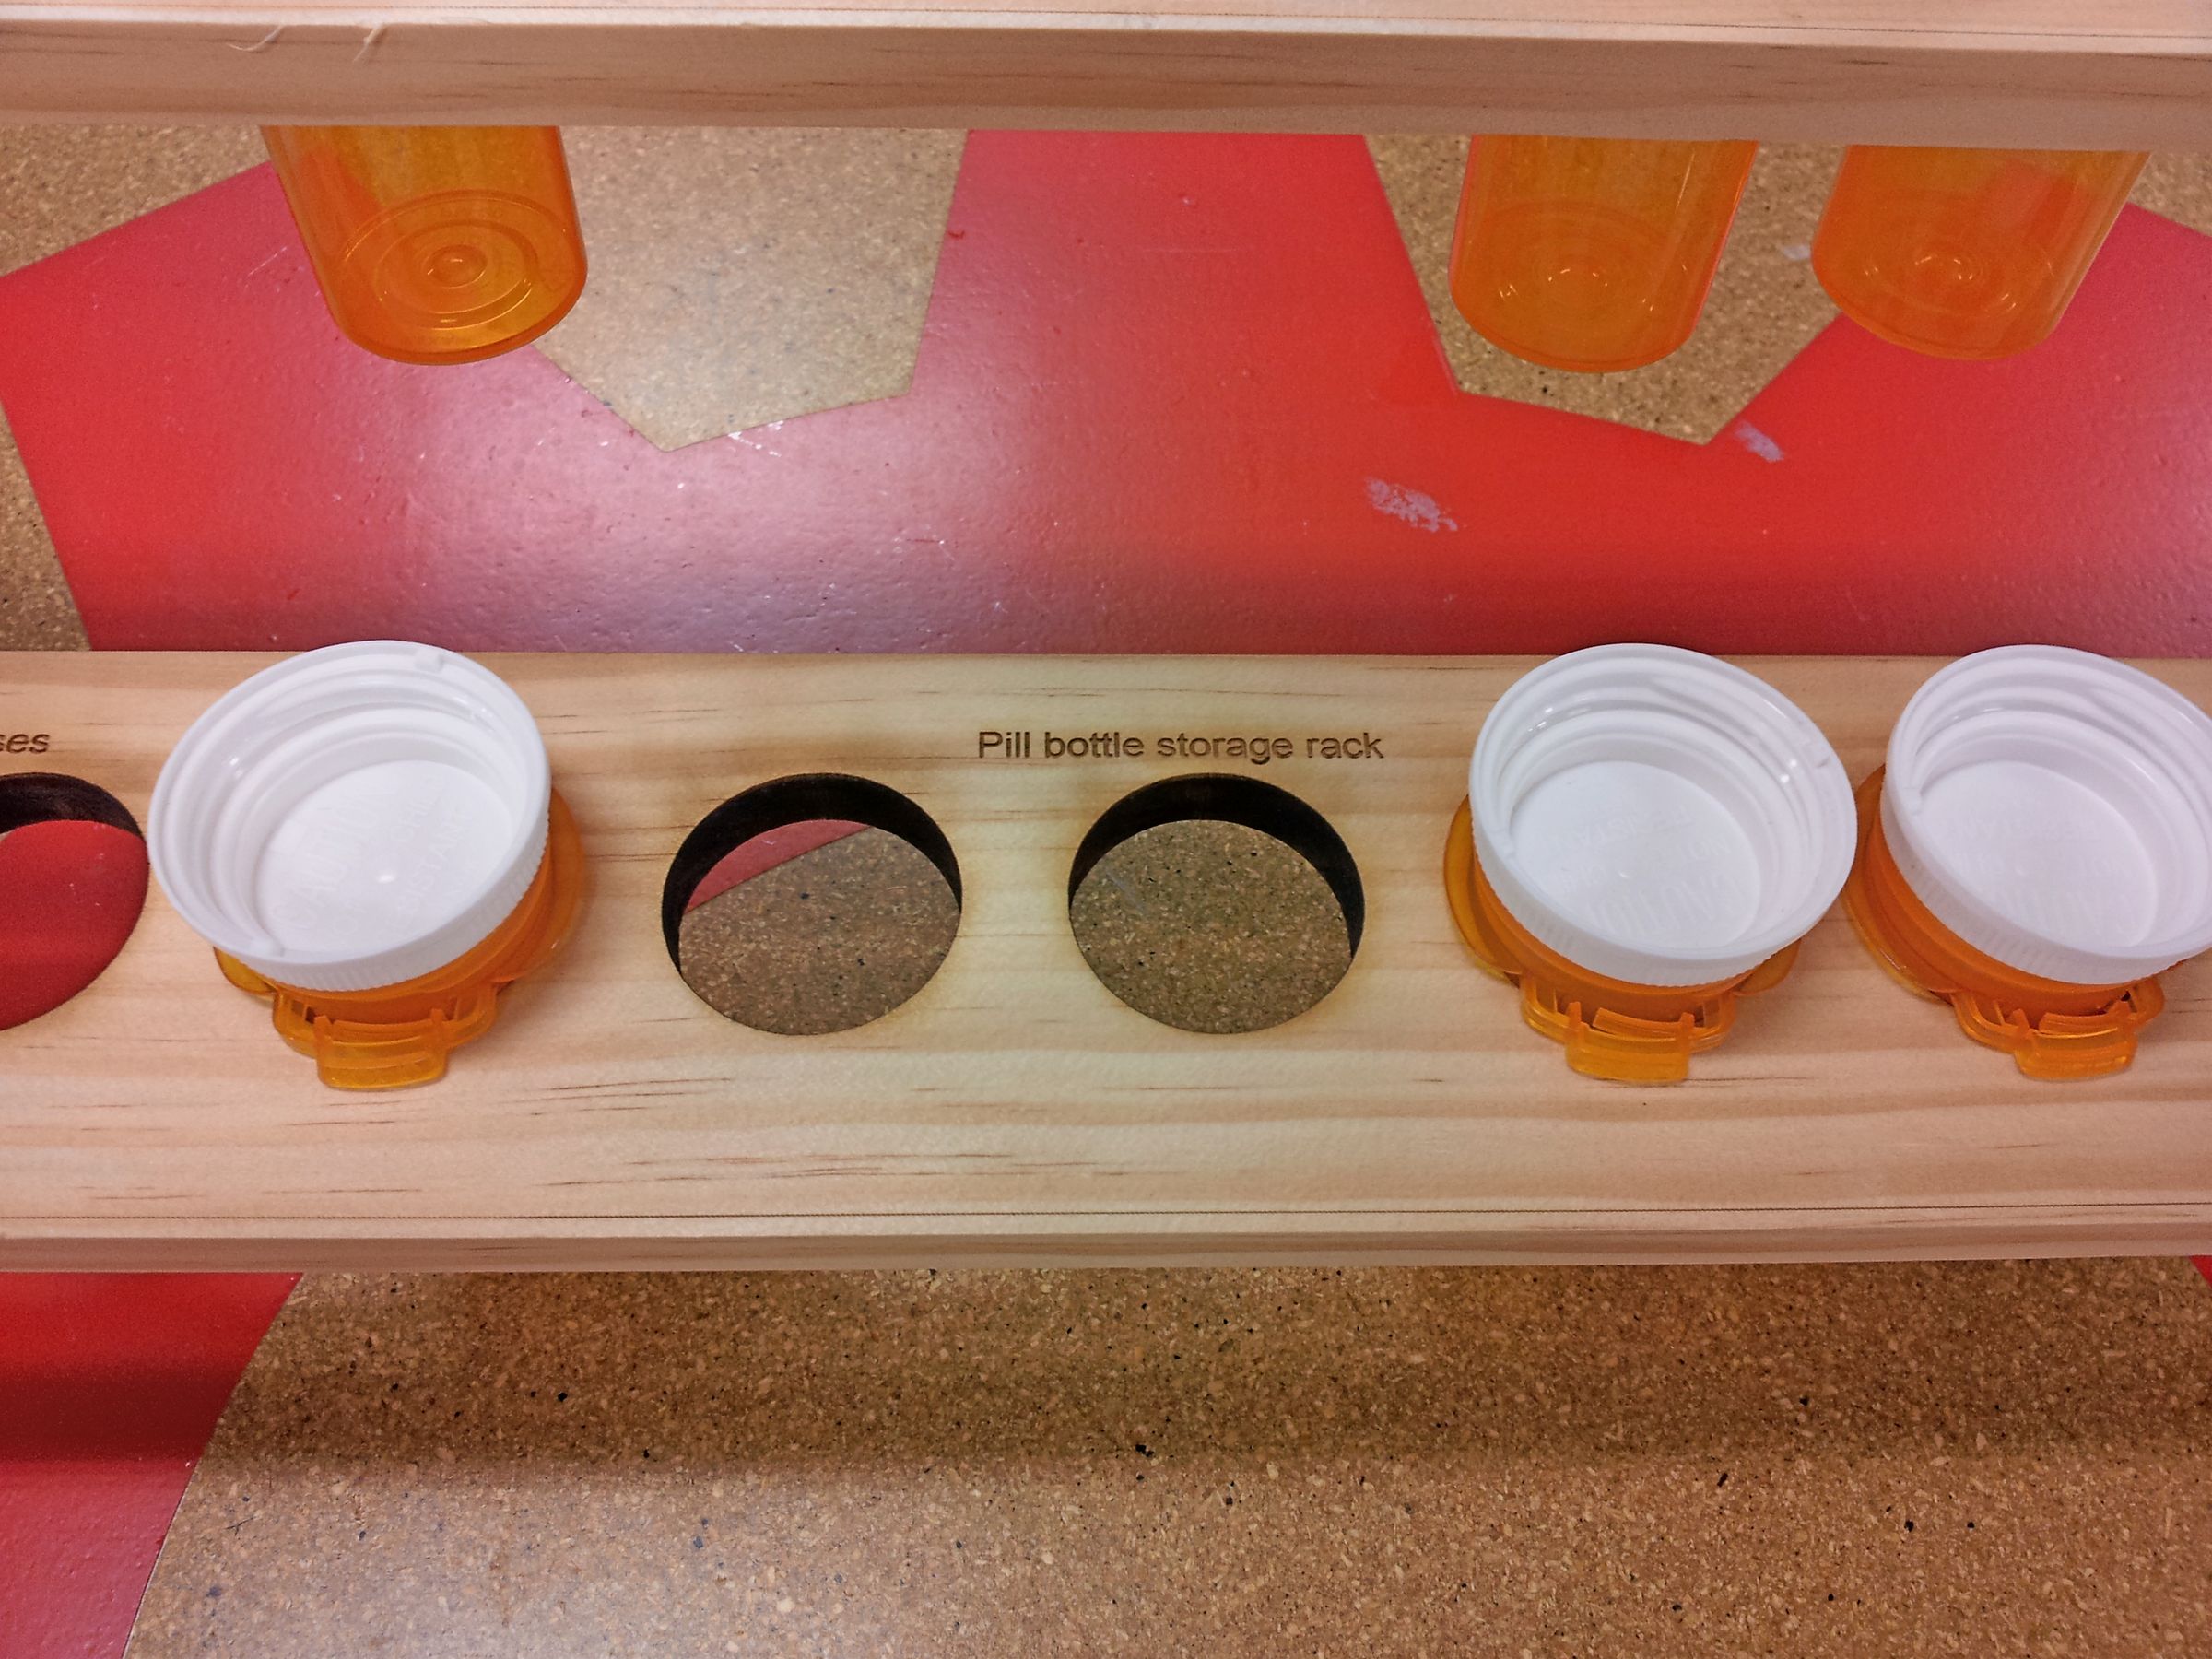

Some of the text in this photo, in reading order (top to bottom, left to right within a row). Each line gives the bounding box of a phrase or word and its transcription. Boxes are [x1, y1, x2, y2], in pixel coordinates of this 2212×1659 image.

[978, 731, 1384, 765] Pill bottle storage rack
